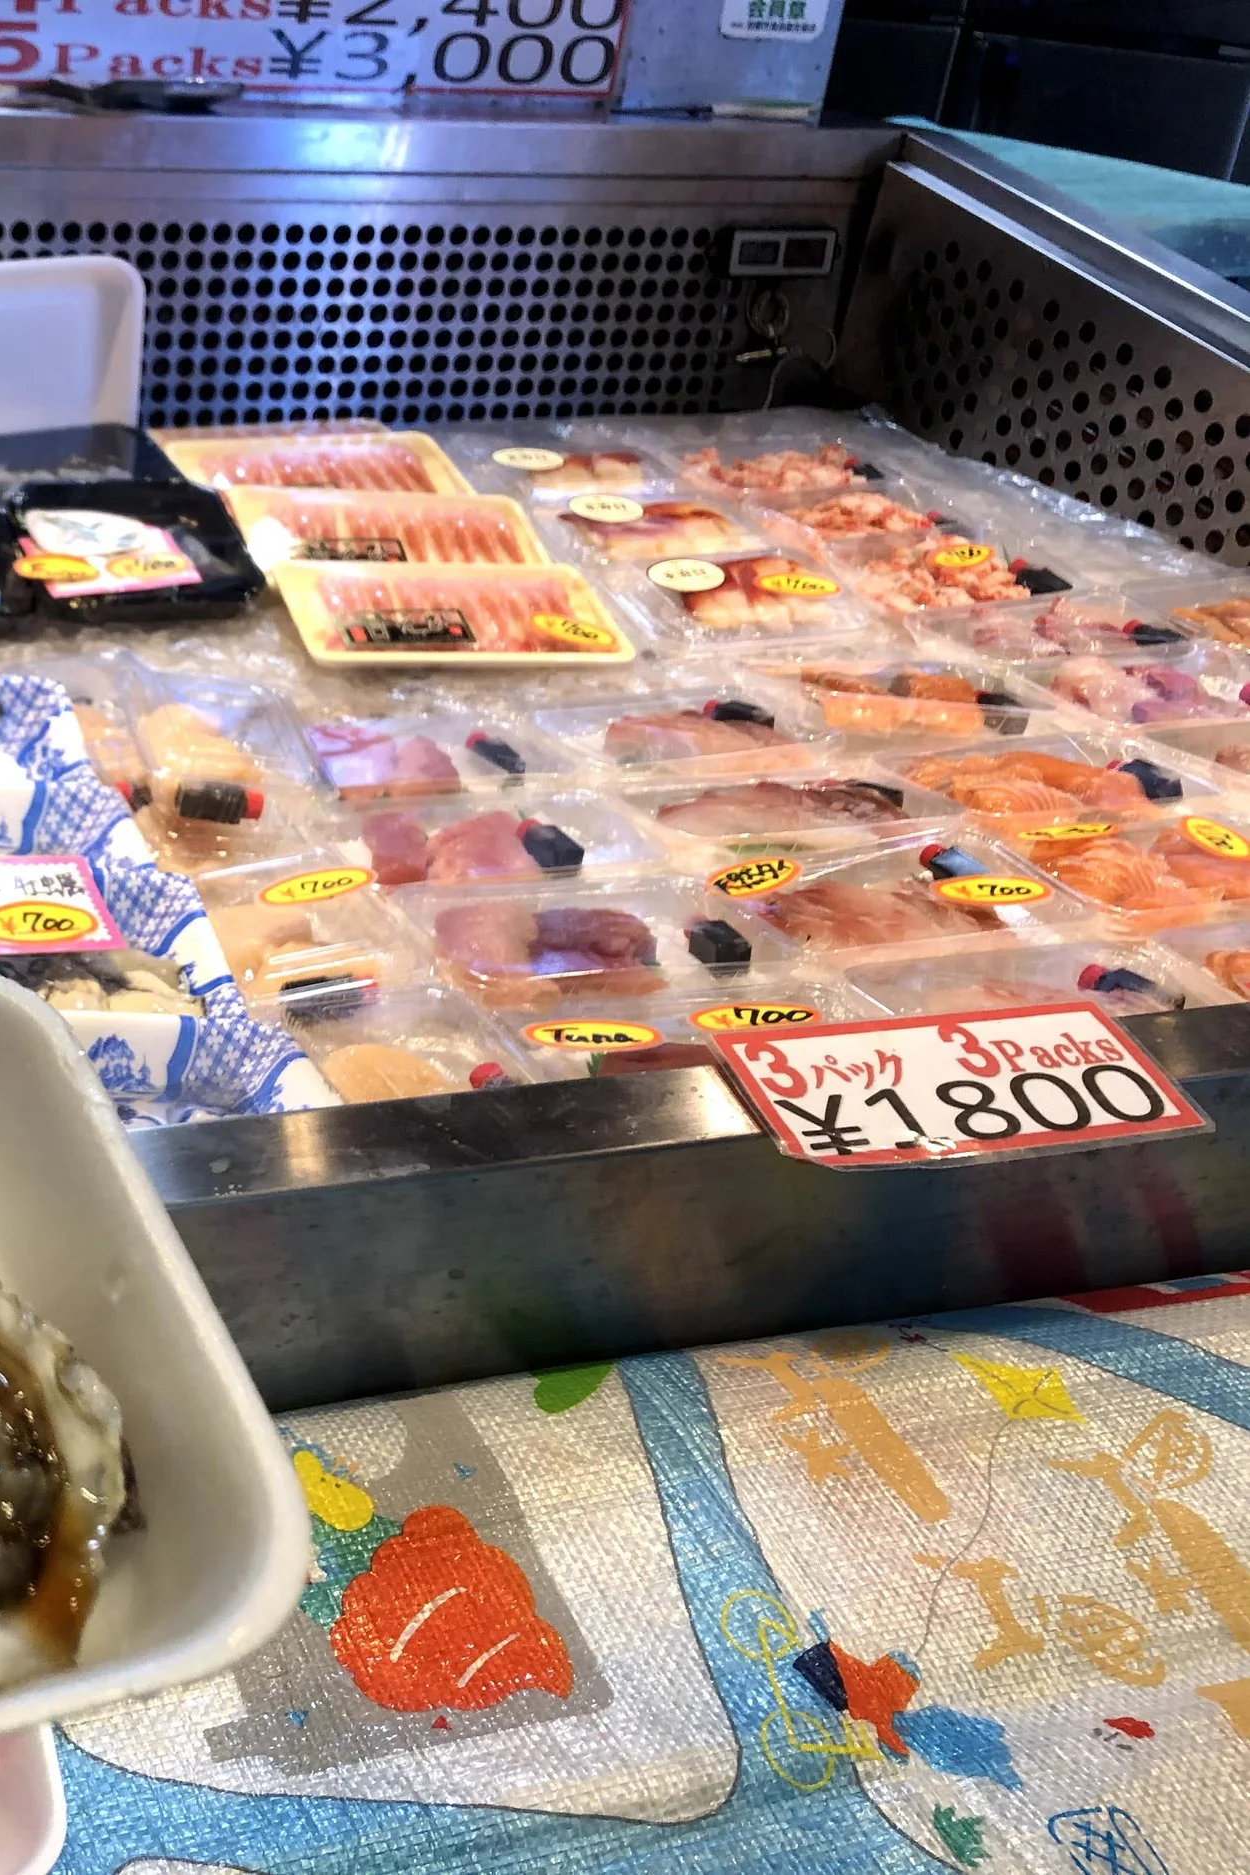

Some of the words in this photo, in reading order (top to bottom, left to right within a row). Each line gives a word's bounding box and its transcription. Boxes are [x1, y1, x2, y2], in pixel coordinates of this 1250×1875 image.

[269, 28, 616, 92] ¥3,000
[277, 876, 353, 898] ¥700
[949, 883, 1032, 899] ¥700
[711, 1006, 813, 1026] ¥700
[543, 1027, 641, 1044] Tuna
